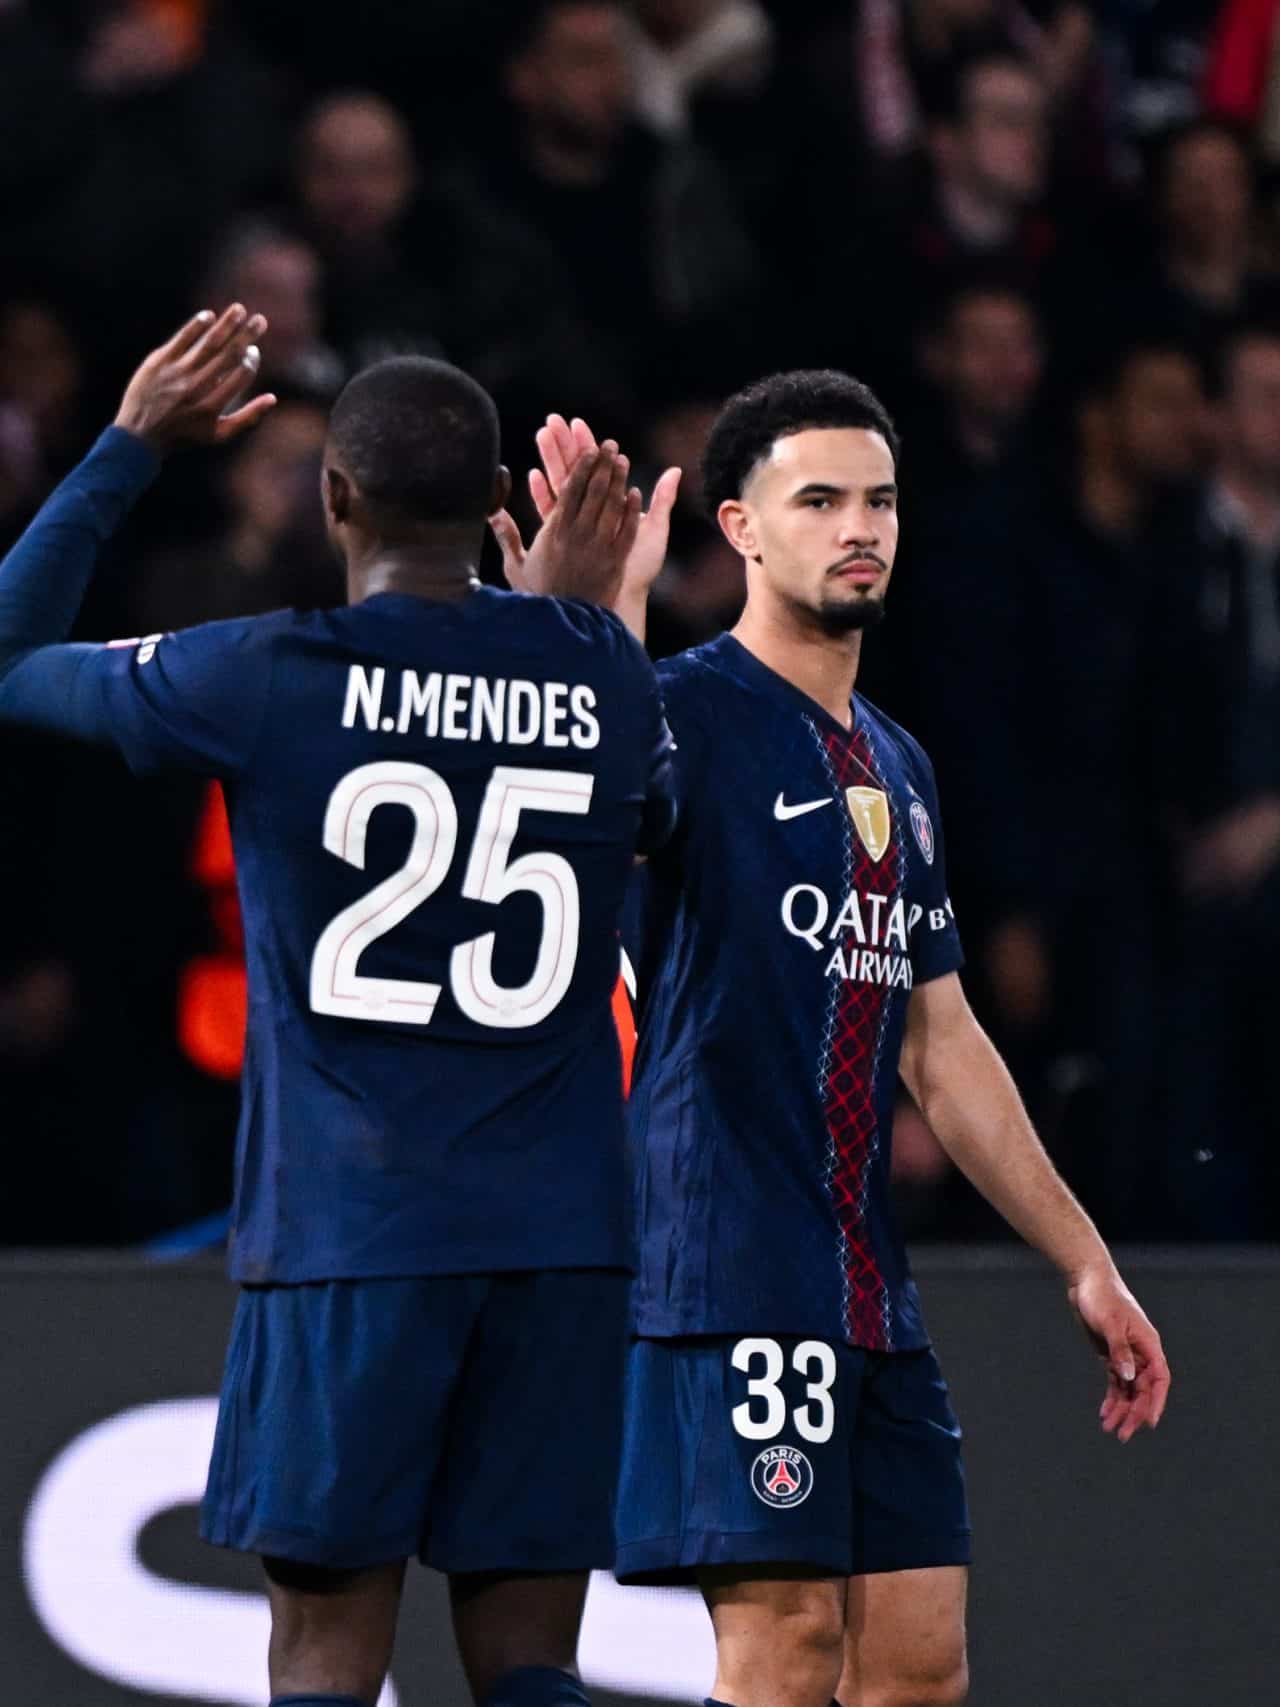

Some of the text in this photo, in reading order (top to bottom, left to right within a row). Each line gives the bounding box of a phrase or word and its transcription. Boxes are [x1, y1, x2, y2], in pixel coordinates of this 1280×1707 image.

[342, 664, 600, 750] N.MENDES
[309, 760, 595, 1029] 25
[731, 1337, 837, 1444] 33
[761, 1448, 802, 1465] PARIS
